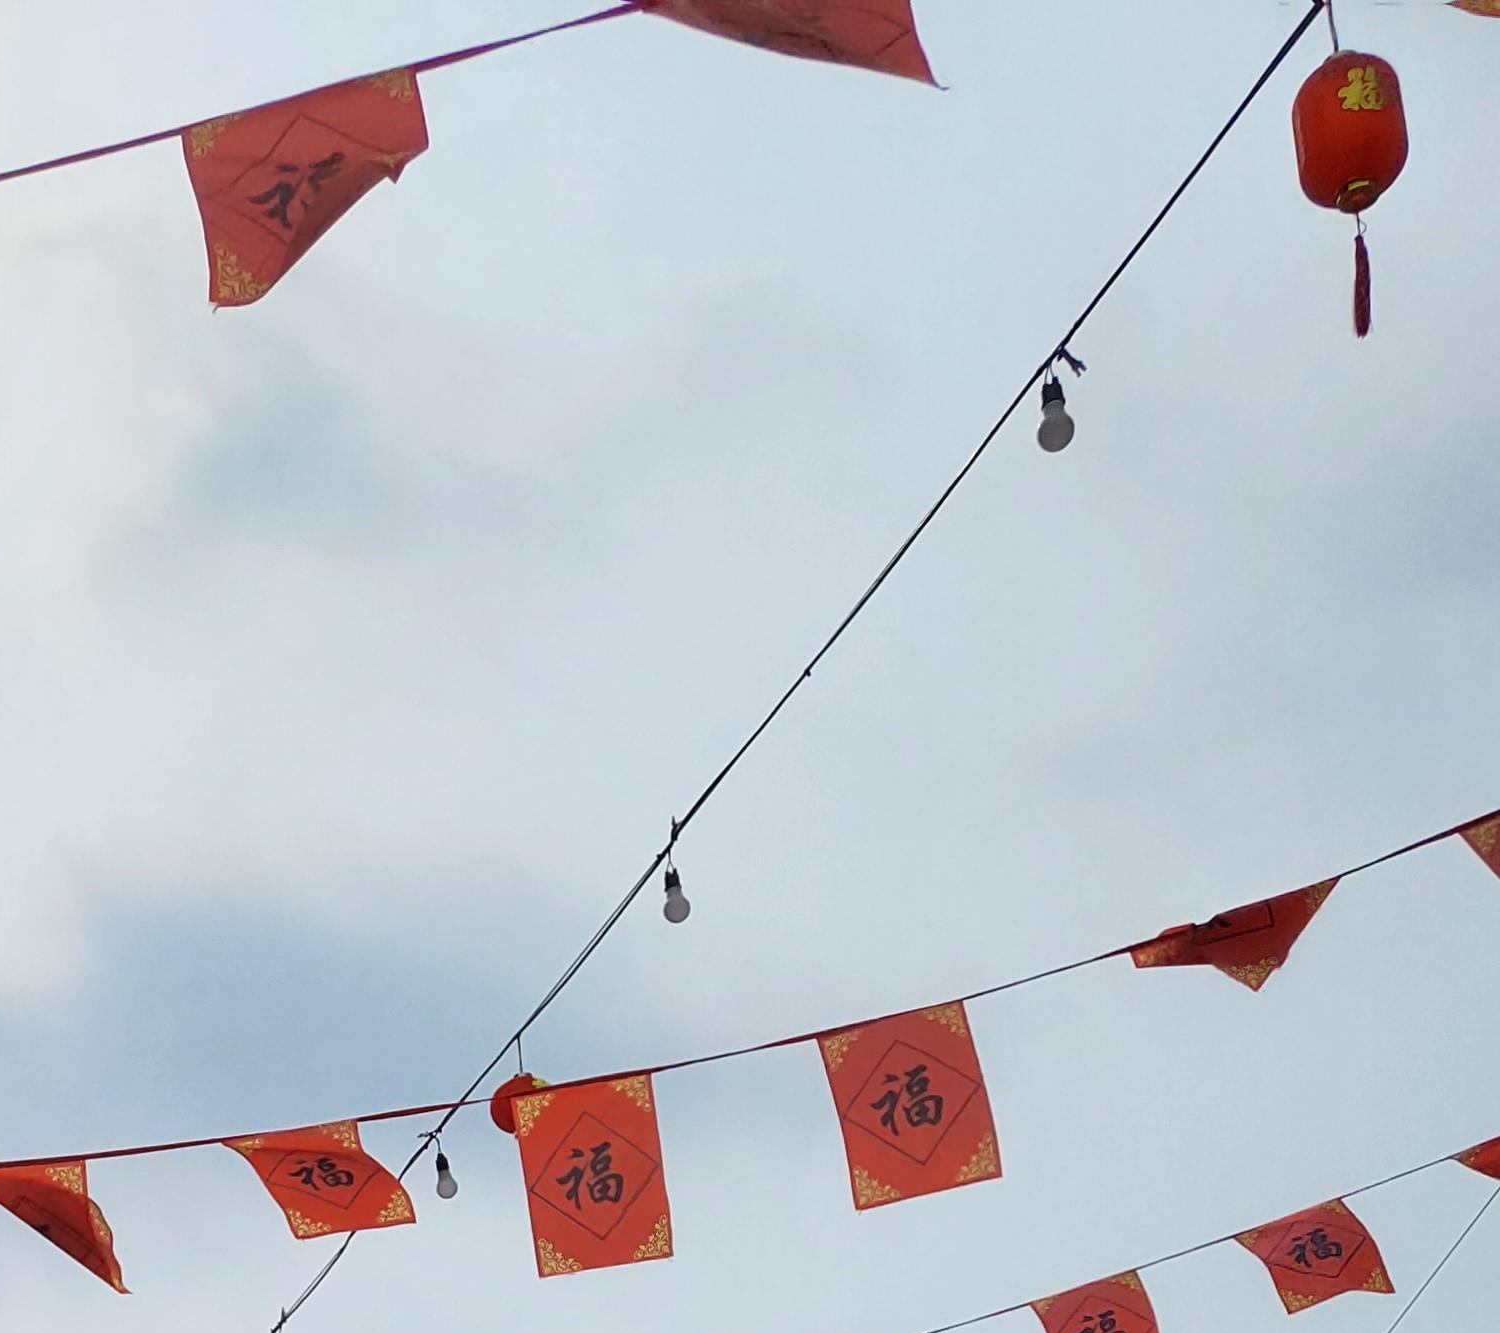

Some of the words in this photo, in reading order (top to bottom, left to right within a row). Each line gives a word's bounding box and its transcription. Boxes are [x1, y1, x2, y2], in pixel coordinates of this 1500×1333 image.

[1337, 66, 1390, 112] 福
[871, 1064, 944, 1136] 福
[287, 1158, 354, 1190] 福
[557, 1142, 625, 1209] 福
[1287, 1228, 1345, 1269] 福
